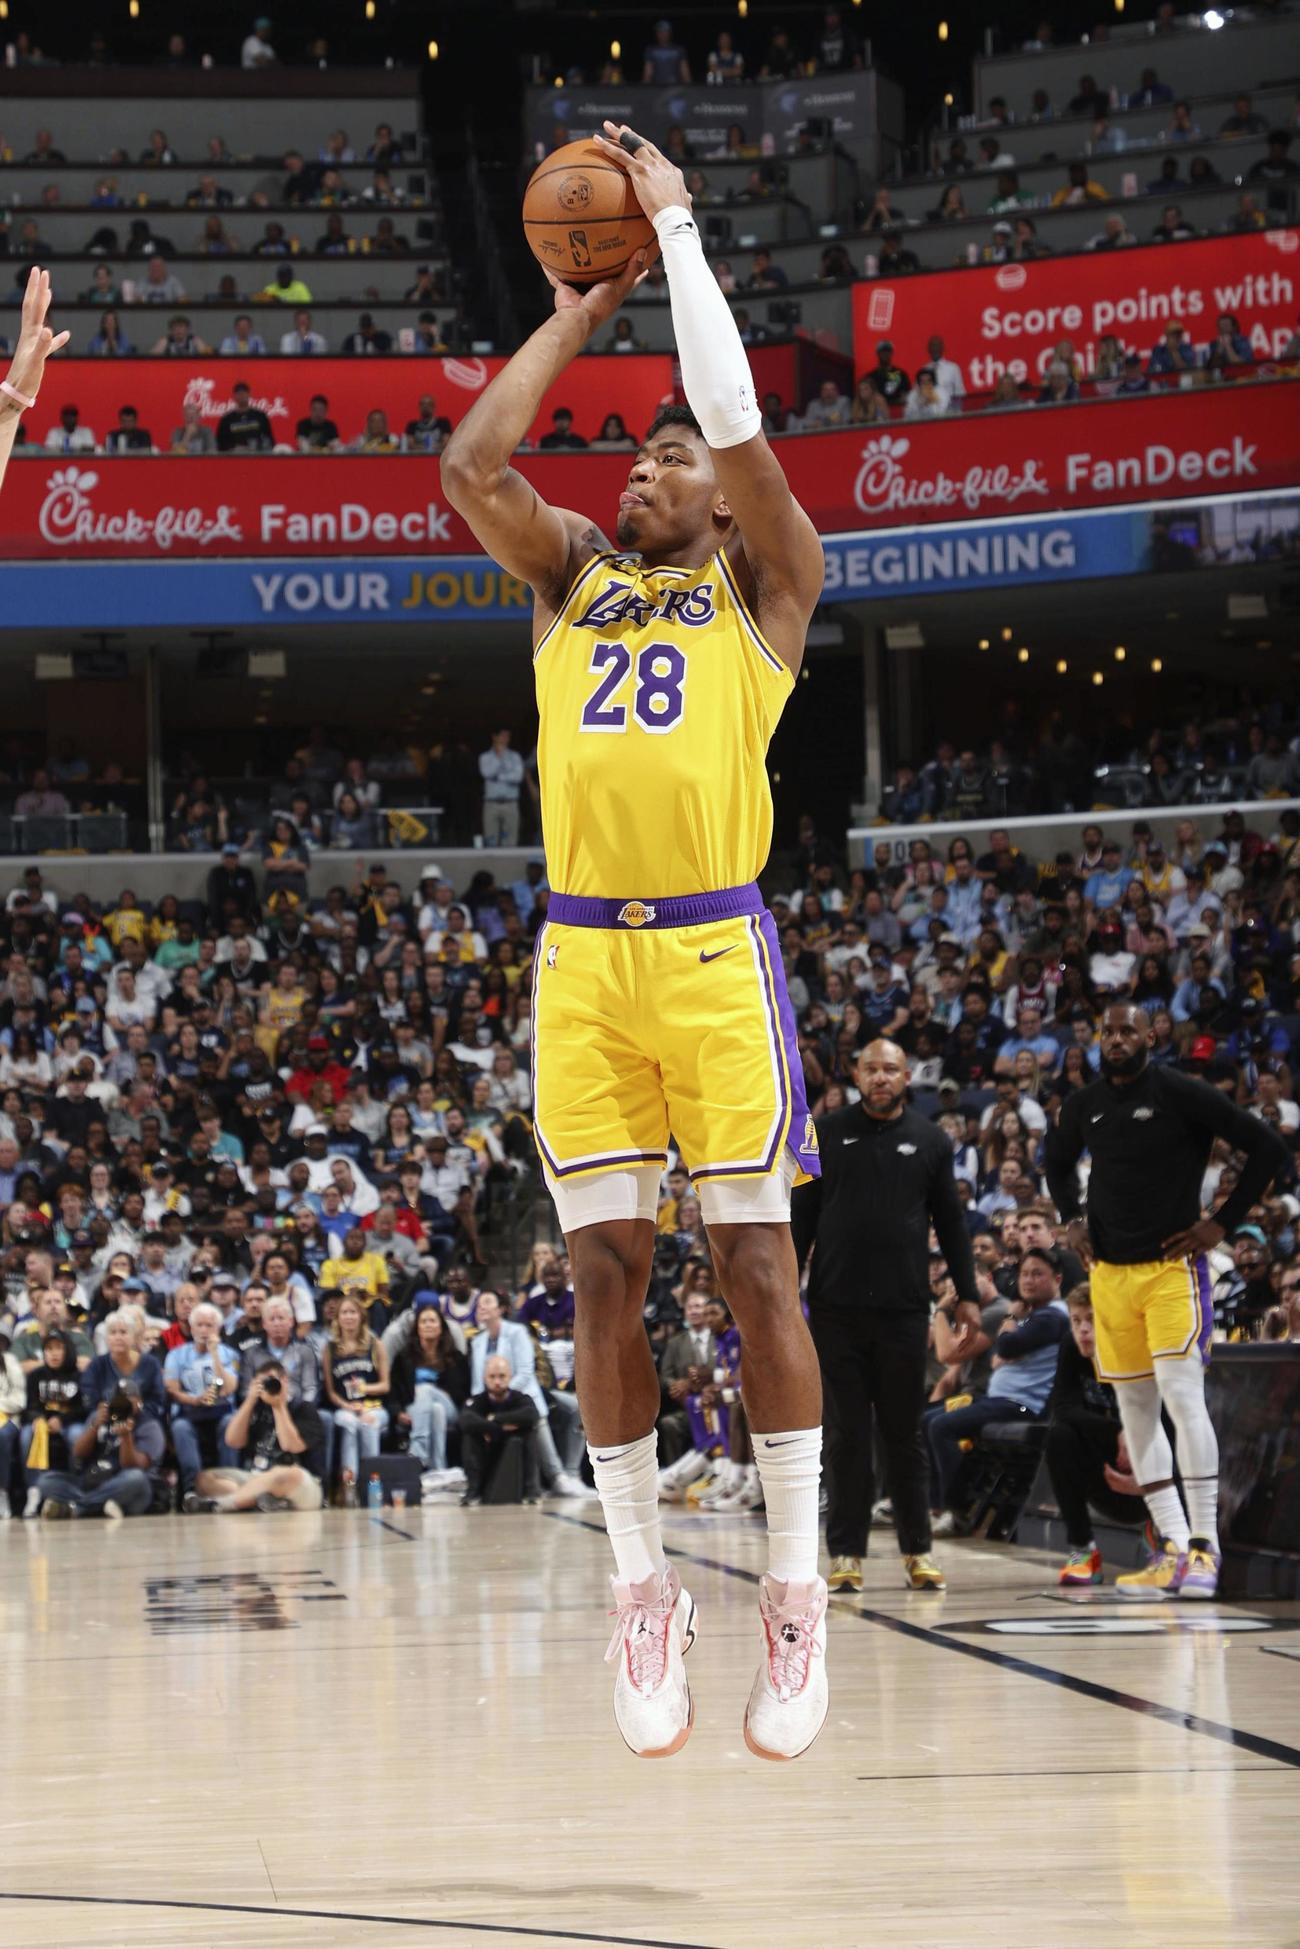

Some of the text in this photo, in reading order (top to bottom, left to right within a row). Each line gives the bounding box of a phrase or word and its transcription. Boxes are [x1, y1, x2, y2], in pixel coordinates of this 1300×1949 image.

[981, 272, 1292, 339] Score points with
[969, 353, 1028, 387] the
[854, 434, 1258, 514] Chick-fil-A FanDeck
[38, 466, 451, 549] Chick-fil-A FanDeck
[825, 531, 1076, 589] BEGINNING
[251, 573, 390, 611] YOUR
[579, 641, 688, 735] 28
[618, 906, 656, 922] LAKERS
